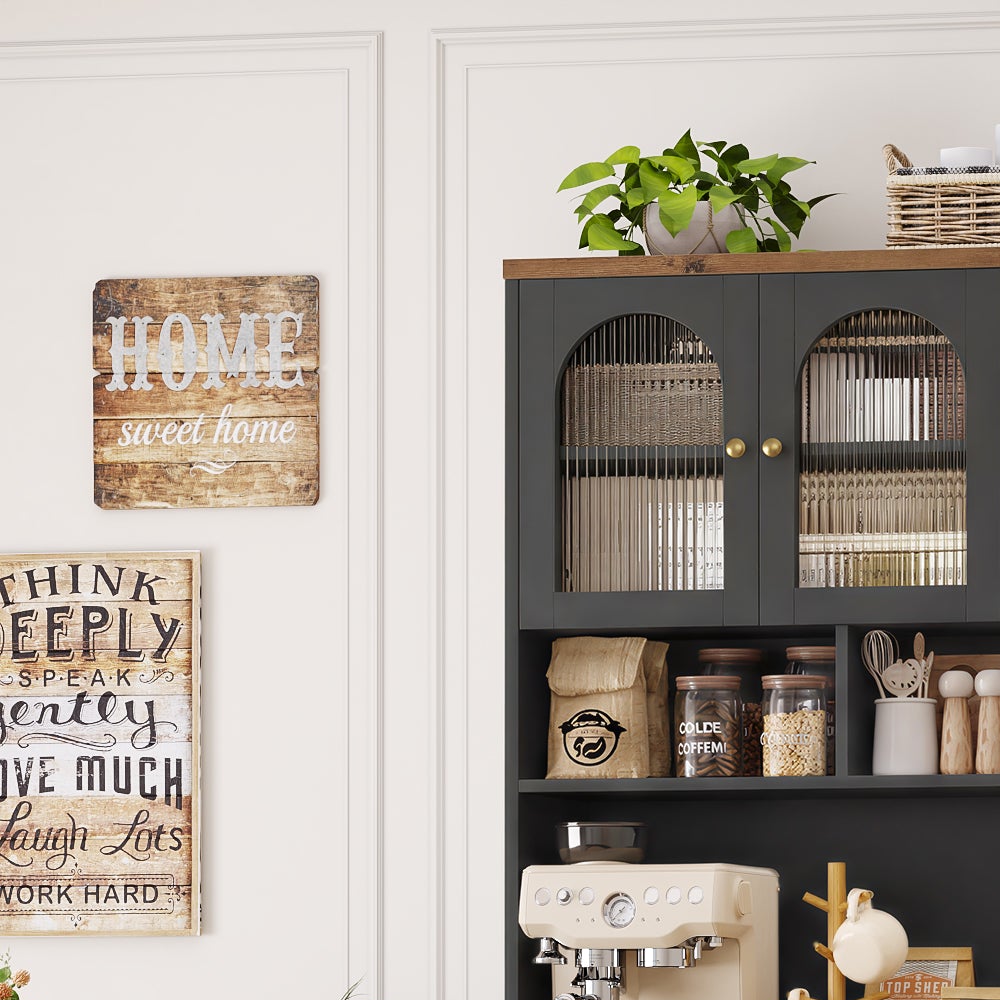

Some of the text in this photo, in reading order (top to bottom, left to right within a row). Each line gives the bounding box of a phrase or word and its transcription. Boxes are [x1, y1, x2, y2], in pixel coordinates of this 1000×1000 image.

[105, 309, 305, 392] HOME
[118, 403, 298, 446] sweet home
[0, 564, 166, 608] THINK
[0, 605, 184, 664] EEPLY
[76, 755, 183, 810] MUCH
[0, 800, 183, 870] Laugh Lots
[84, 884, 159, 904] HARD
